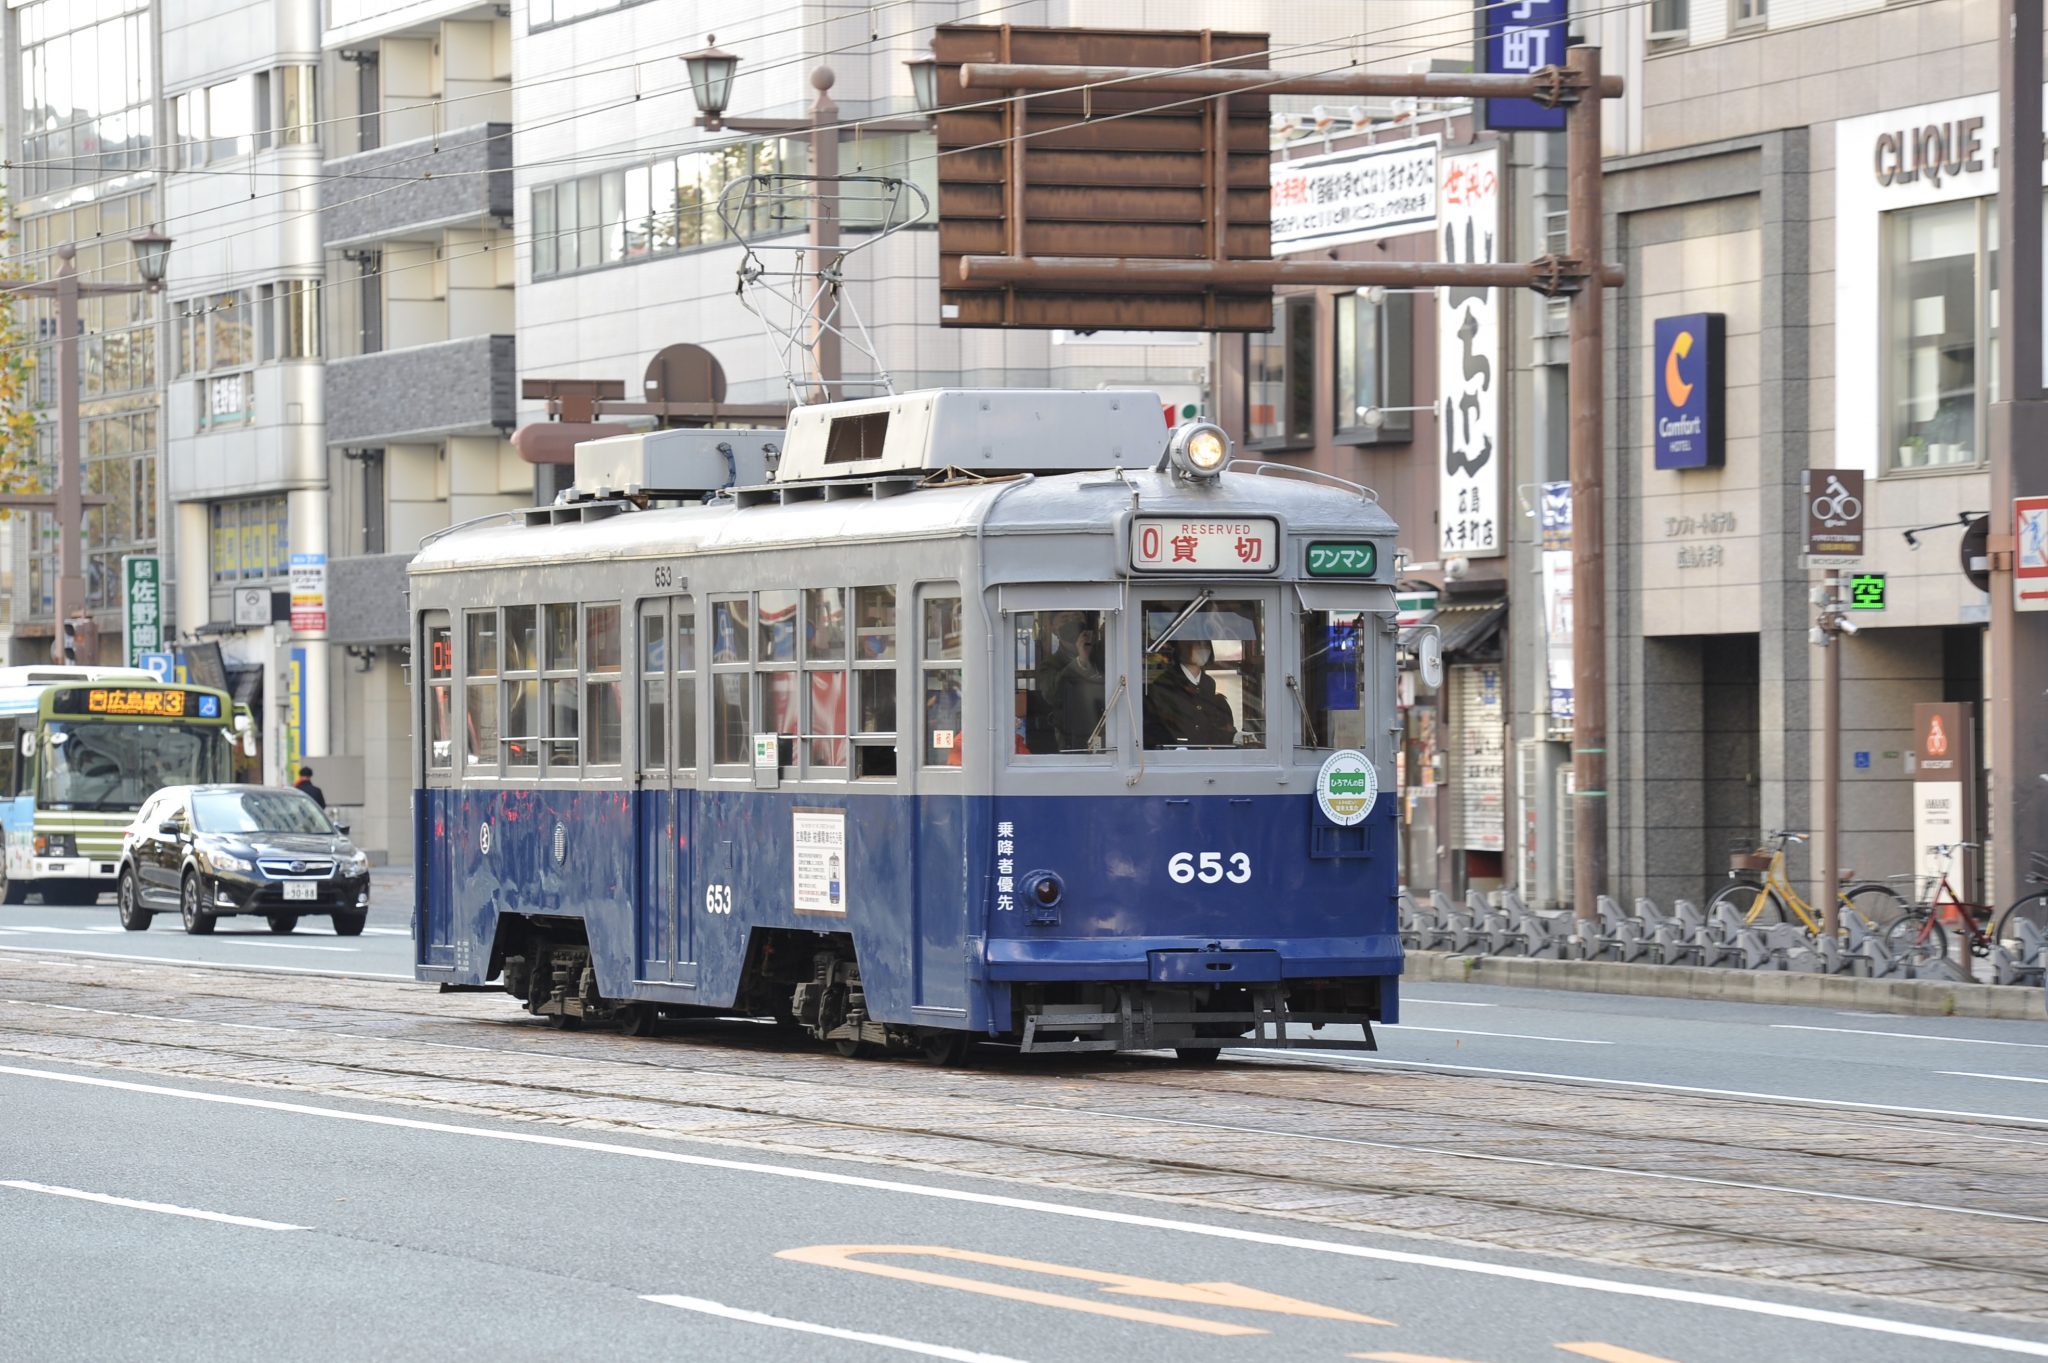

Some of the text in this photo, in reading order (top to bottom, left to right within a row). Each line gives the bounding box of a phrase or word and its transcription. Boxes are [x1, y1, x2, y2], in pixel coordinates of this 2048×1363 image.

[1875, 116, 1984, 188] CLIQUE
[1659, 414, 1702, 438] Comfort
[1458, 486, 1480, 514] 広島
[1142, 527, 1159, 559] 0
[1181, 524, 1251, 535] RESERVED
[1444, 518, 1493, 549] 大手町店
[1310, 549, 1371, 569] ワンマン
[655, 566, 672, 588] 653
[1850, 574, 1885, 609] 空
[107, 690, 181, 712] 広島駅 3
[1330, 778, 1364, 788] ひろでんの日
[997, 821, 1014, 912] 乗降者優先
[1168, 852, 1251, 884] 653
[706, 884, 731, 915] 653
